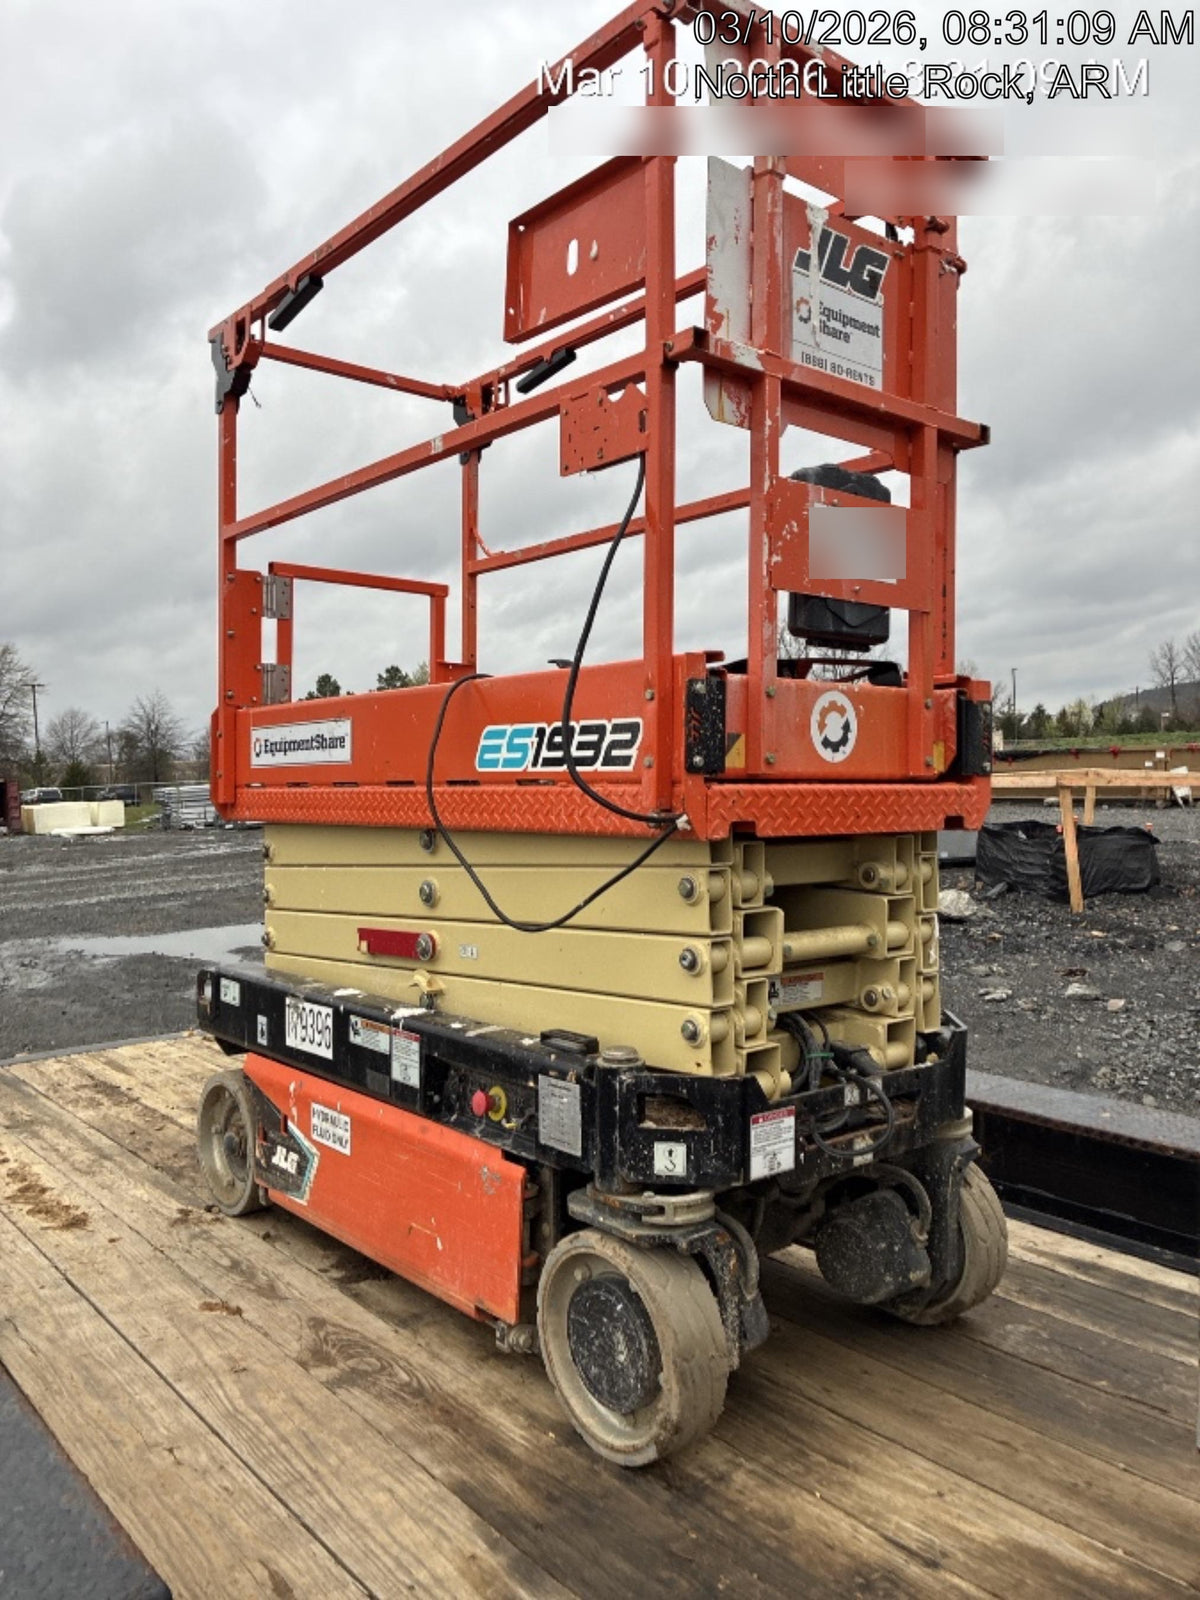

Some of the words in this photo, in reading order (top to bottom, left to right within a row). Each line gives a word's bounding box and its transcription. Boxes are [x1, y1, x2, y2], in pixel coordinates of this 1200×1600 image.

[792, 227, 891, 300] JLG
[263, 732, 346, 757] EquipmentShare
[476, 718, 642, 771] ES1932
[271, 1145, 299, 1175] JLG
